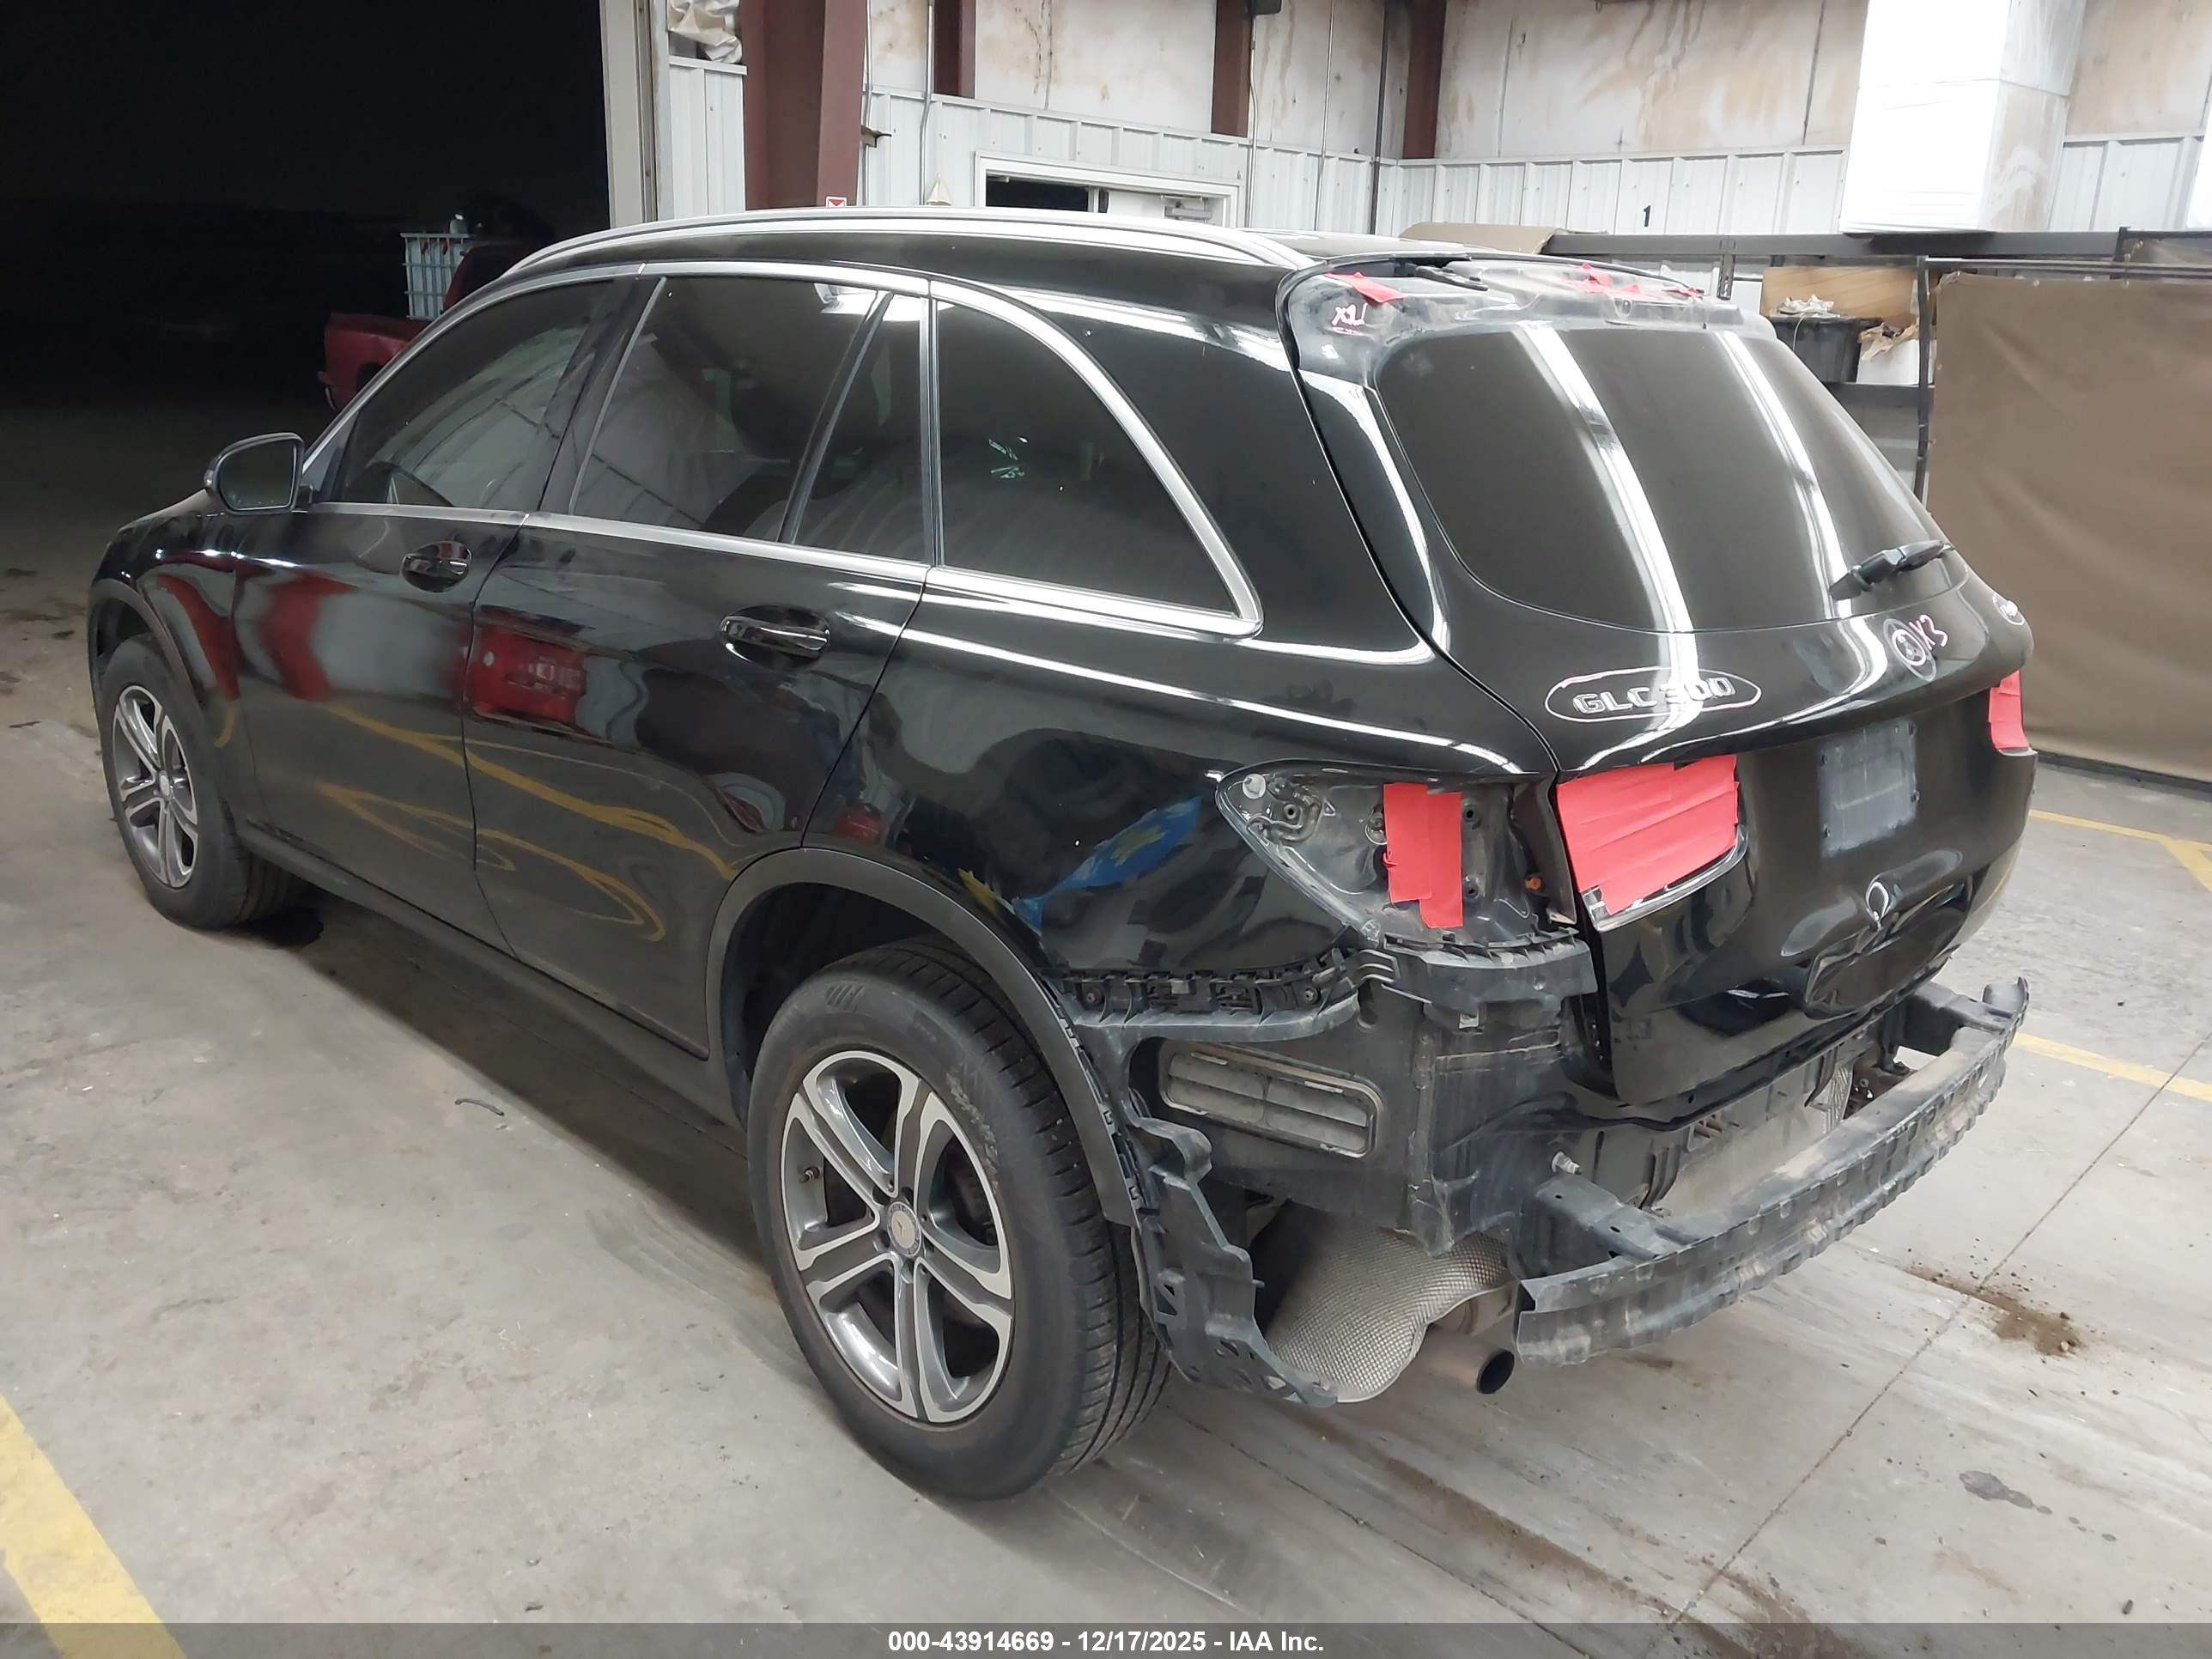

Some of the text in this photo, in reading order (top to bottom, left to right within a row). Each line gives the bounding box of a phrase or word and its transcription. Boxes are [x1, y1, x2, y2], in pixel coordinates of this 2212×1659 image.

[1644, 204, 1651, 228] 1
[1908, 614, 1948, 651] X3
[1572, 677, 1736, 714] GLC 300
